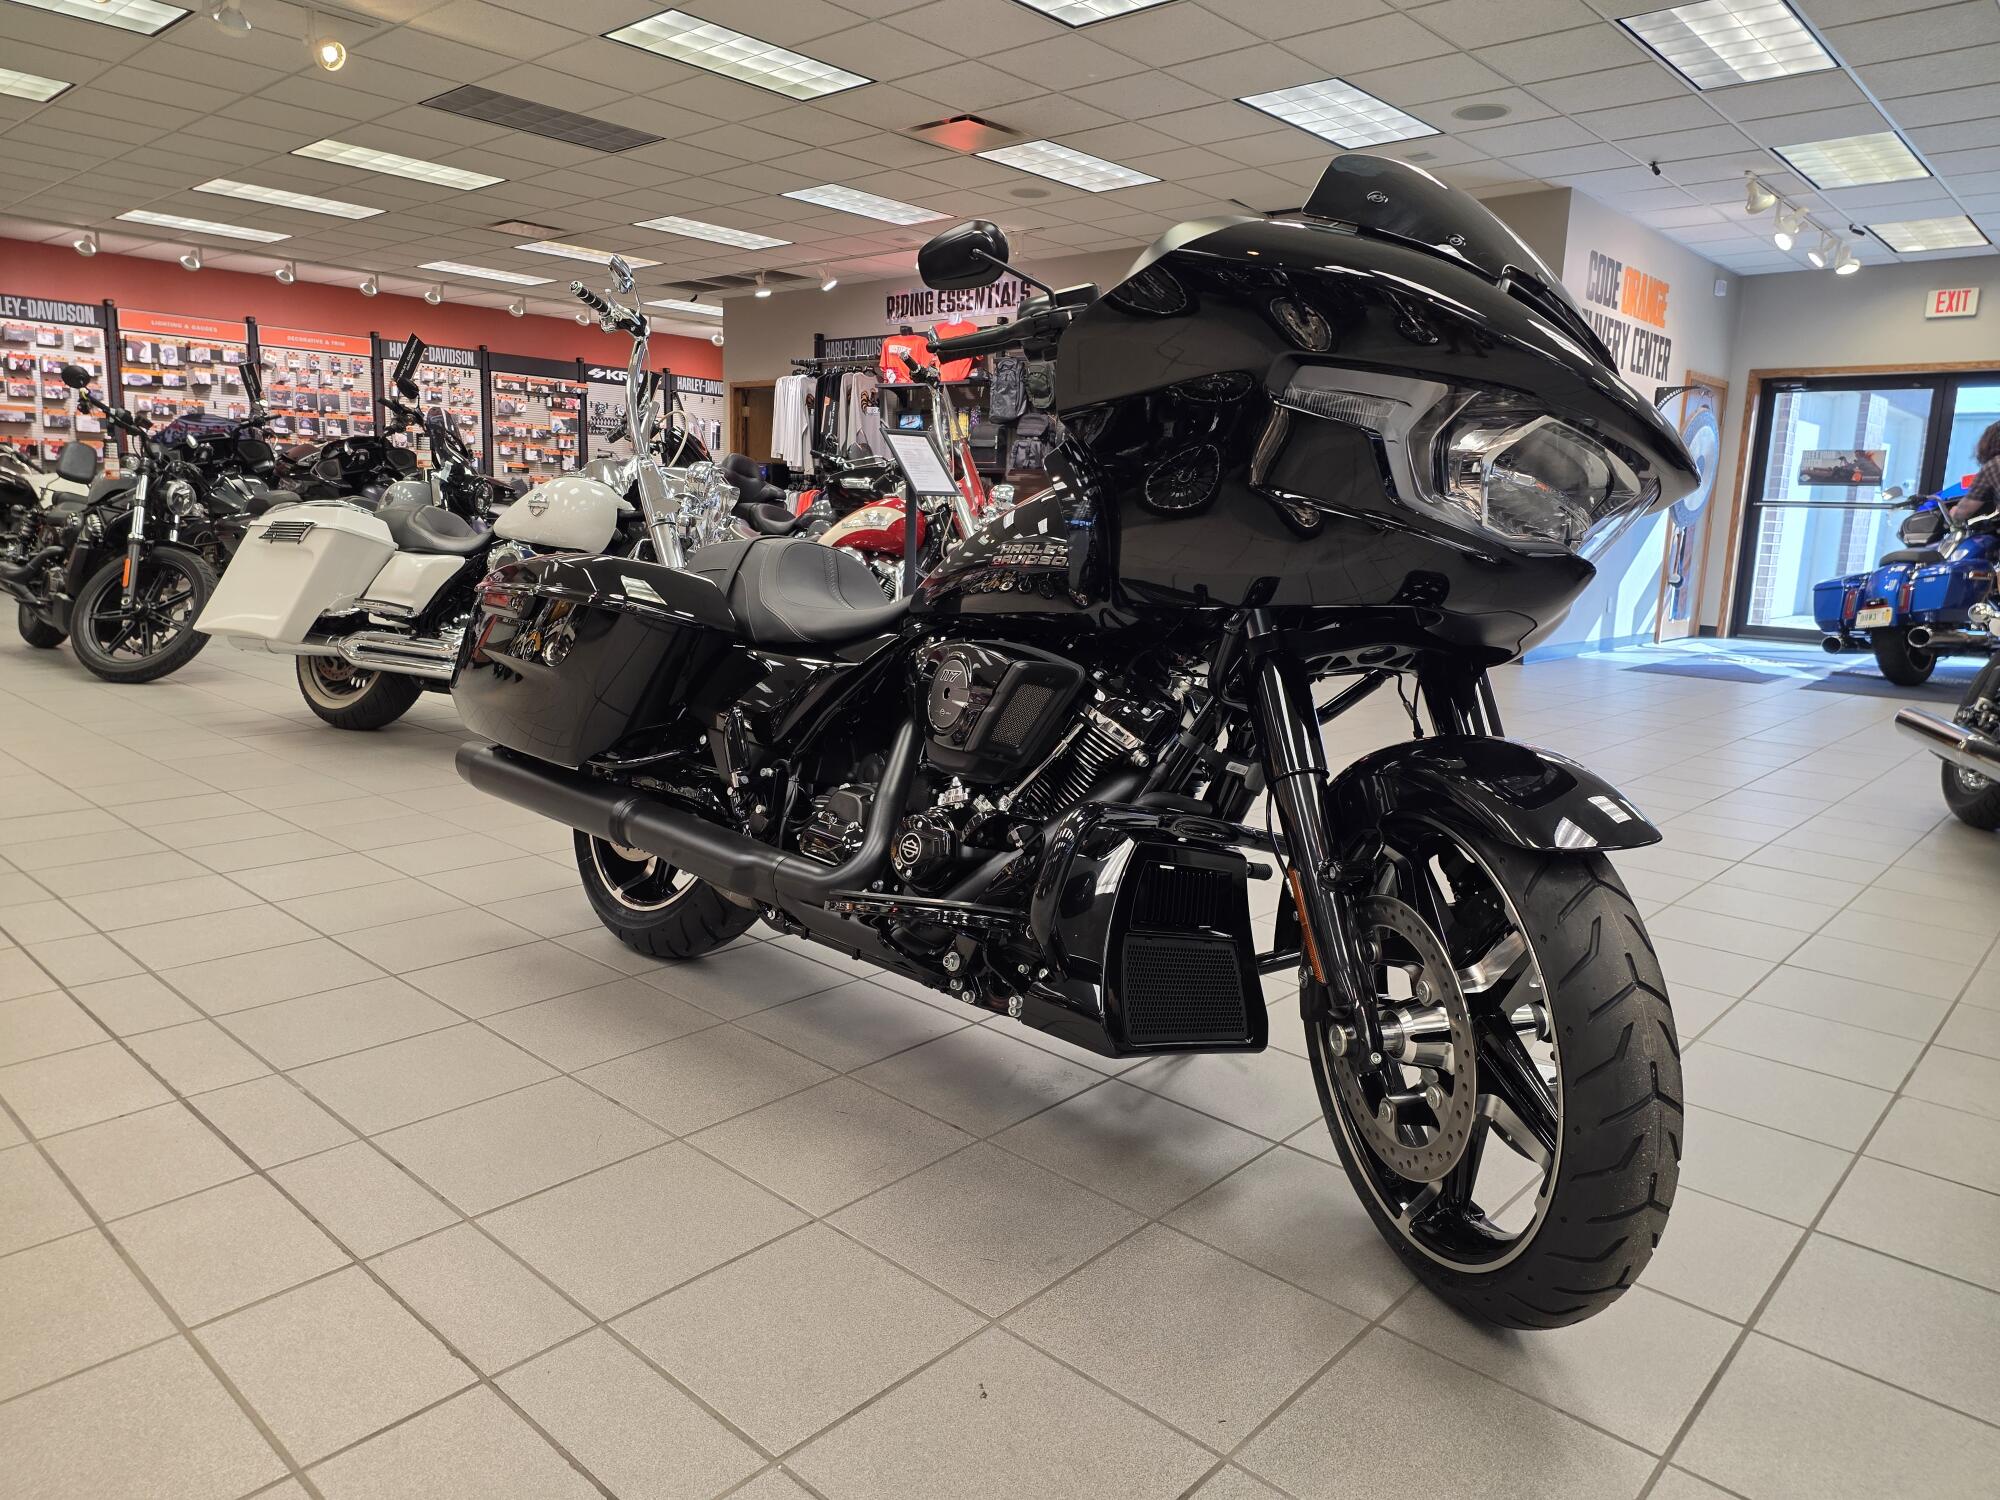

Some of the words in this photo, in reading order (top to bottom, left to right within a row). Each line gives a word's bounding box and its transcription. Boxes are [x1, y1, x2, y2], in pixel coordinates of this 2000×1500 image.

[1586, 249, 1623, 310] CODE
[0, 296, 96, 325] LEY-DAVIDSON
[886, 290, 934, 320] RIDING
[937, 281, 1031, 314] ESSENTIALS
[1935, 289, 1972, 314] EXIT
[389, 342, 475, 368] HA-DAVIDSON
[825, 337, 887, 358] HARLEY-DAVIDS
[1630, 326, 1672, 382] CENTER
[677, 376, 724, 395] HARLEY-DAVID
[992, 554, 1069, 567] DAVIDSO
[1000, 543, 1069, 555] HARLEY
[940, 669, 962, 682] 117
